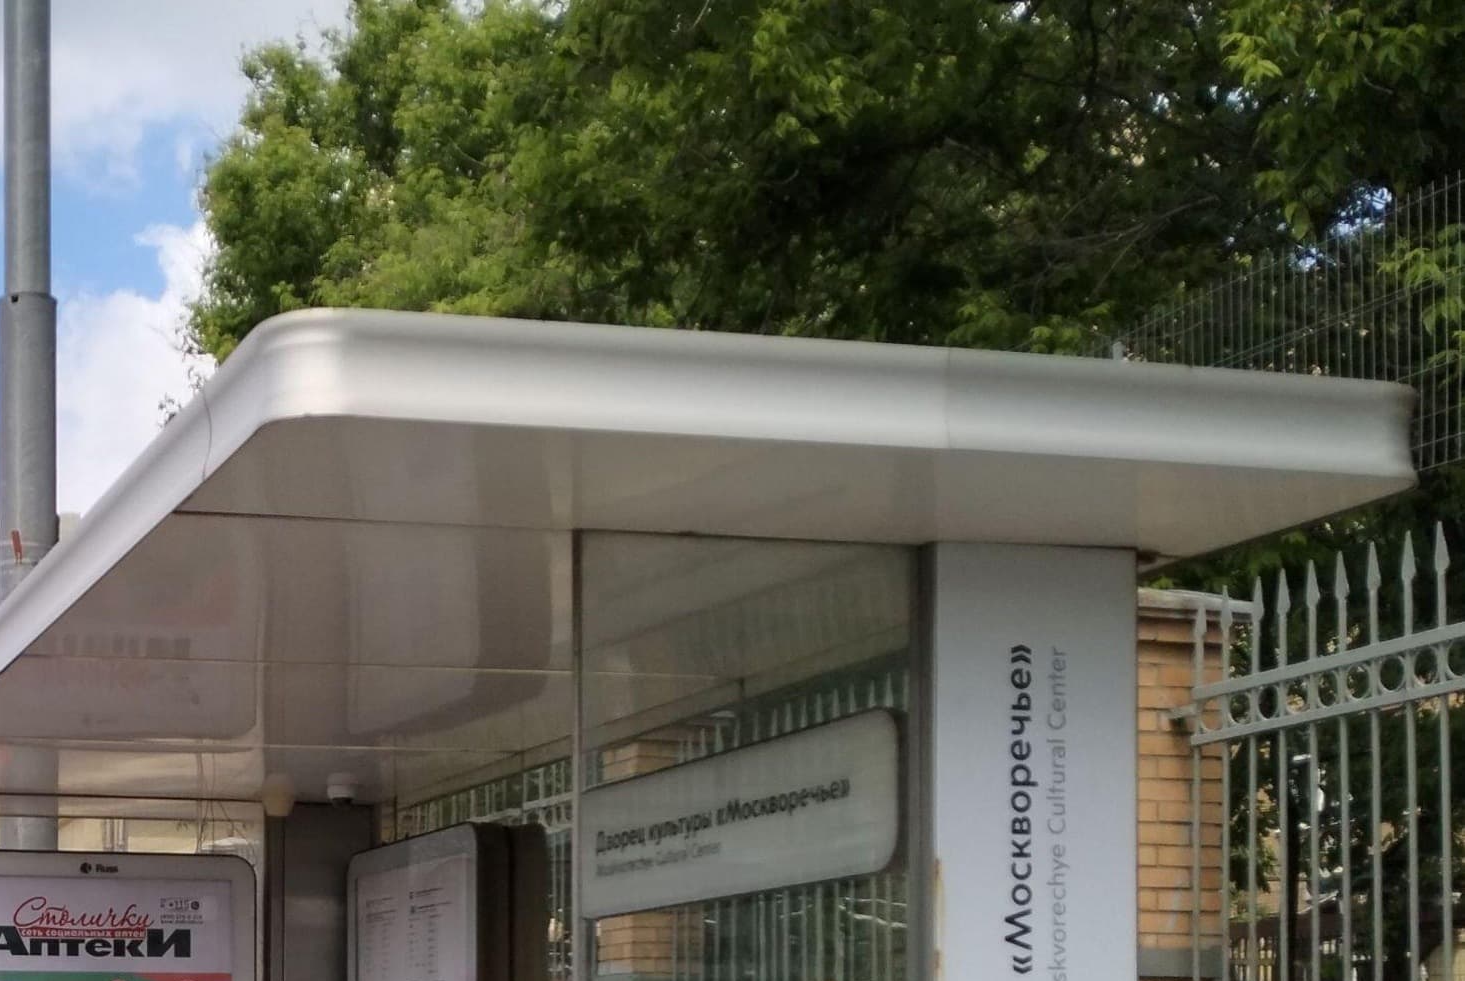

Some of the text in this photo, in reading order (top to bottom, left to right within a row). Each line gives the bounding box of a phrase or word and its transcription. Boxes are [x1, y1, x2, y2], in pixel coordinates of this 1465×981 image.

[1046, 646, 1068, 731] Center
[1004, 643, 1039, 976] «Москворечье»
[1046, 738, 1067, 835] Cultural
[13, 896, 155, 928] Столички
